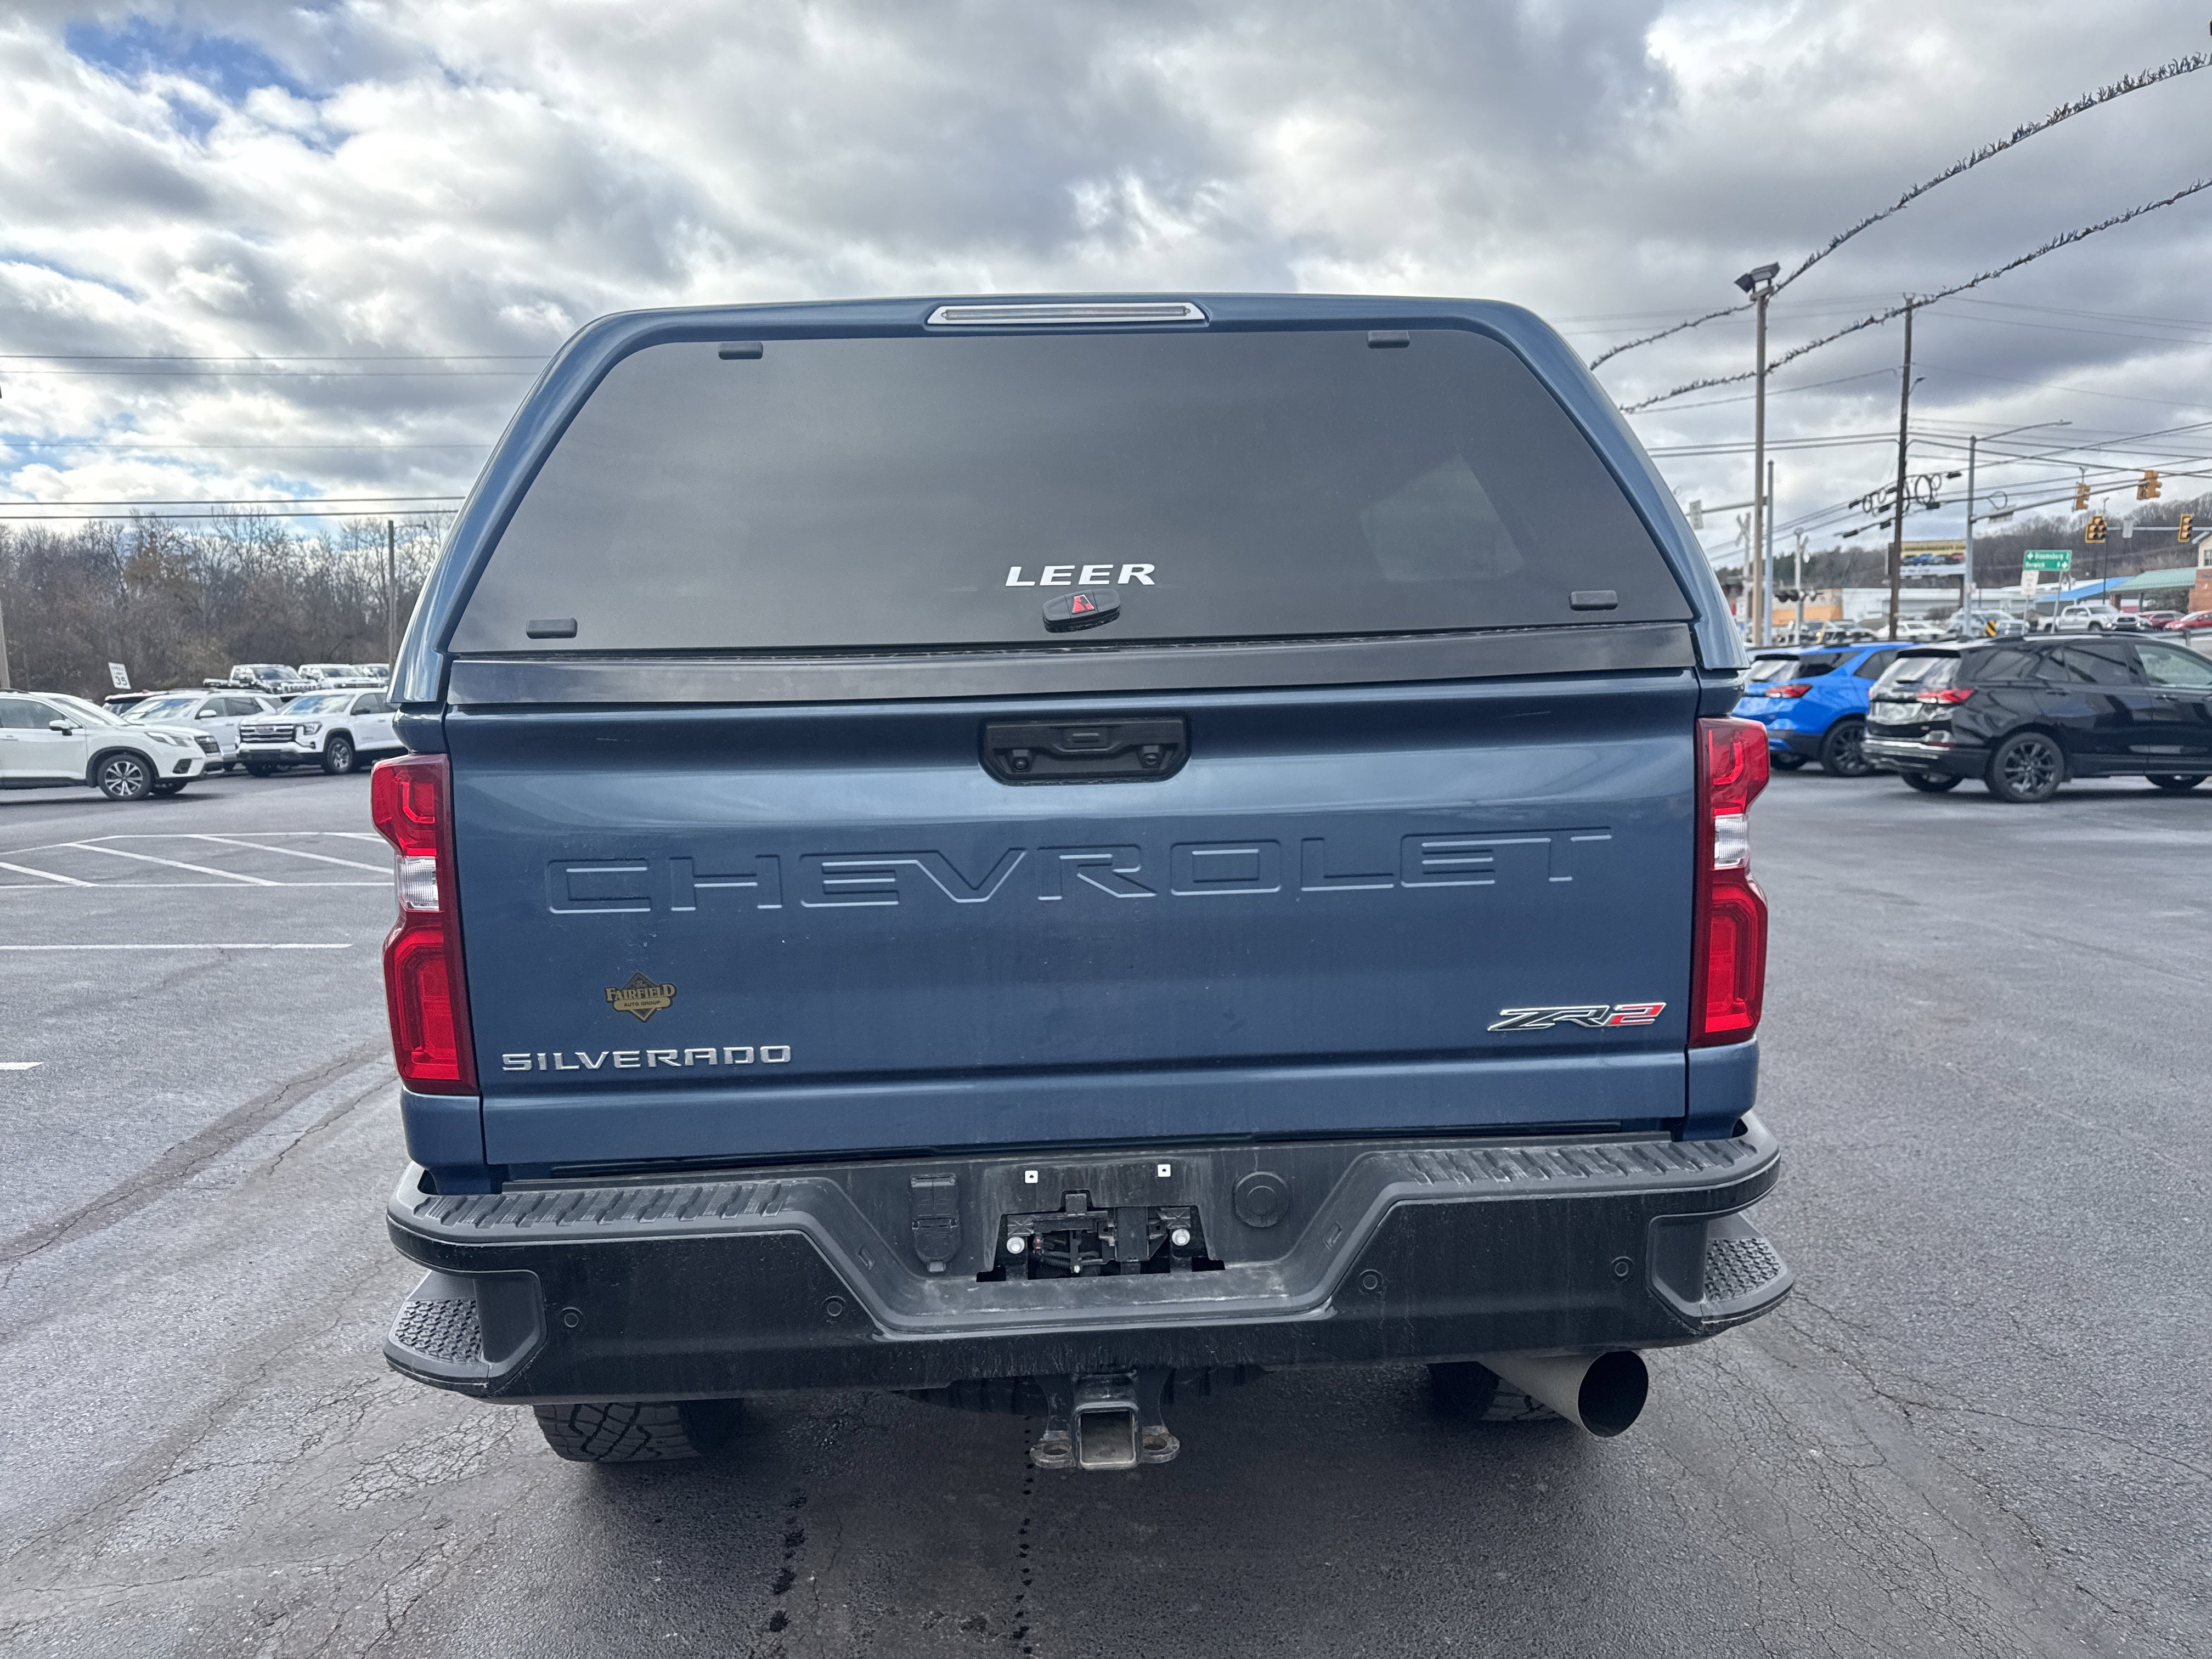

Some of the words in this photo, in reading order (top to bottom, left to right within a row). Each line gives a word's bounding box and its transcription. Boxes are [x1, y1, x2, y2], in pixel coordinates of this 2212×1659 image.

[1005, 563, 1155, 587] LEER
[115, 675, 127, 686] 35
[548, 826, 1613, 915] CHEVROLET
[605, 984, 675, 1001] FAIRFIELD
[1486, 1002, 1667, 1031] ZR2
[501, 1045, 792, 1071] SILVERADO
